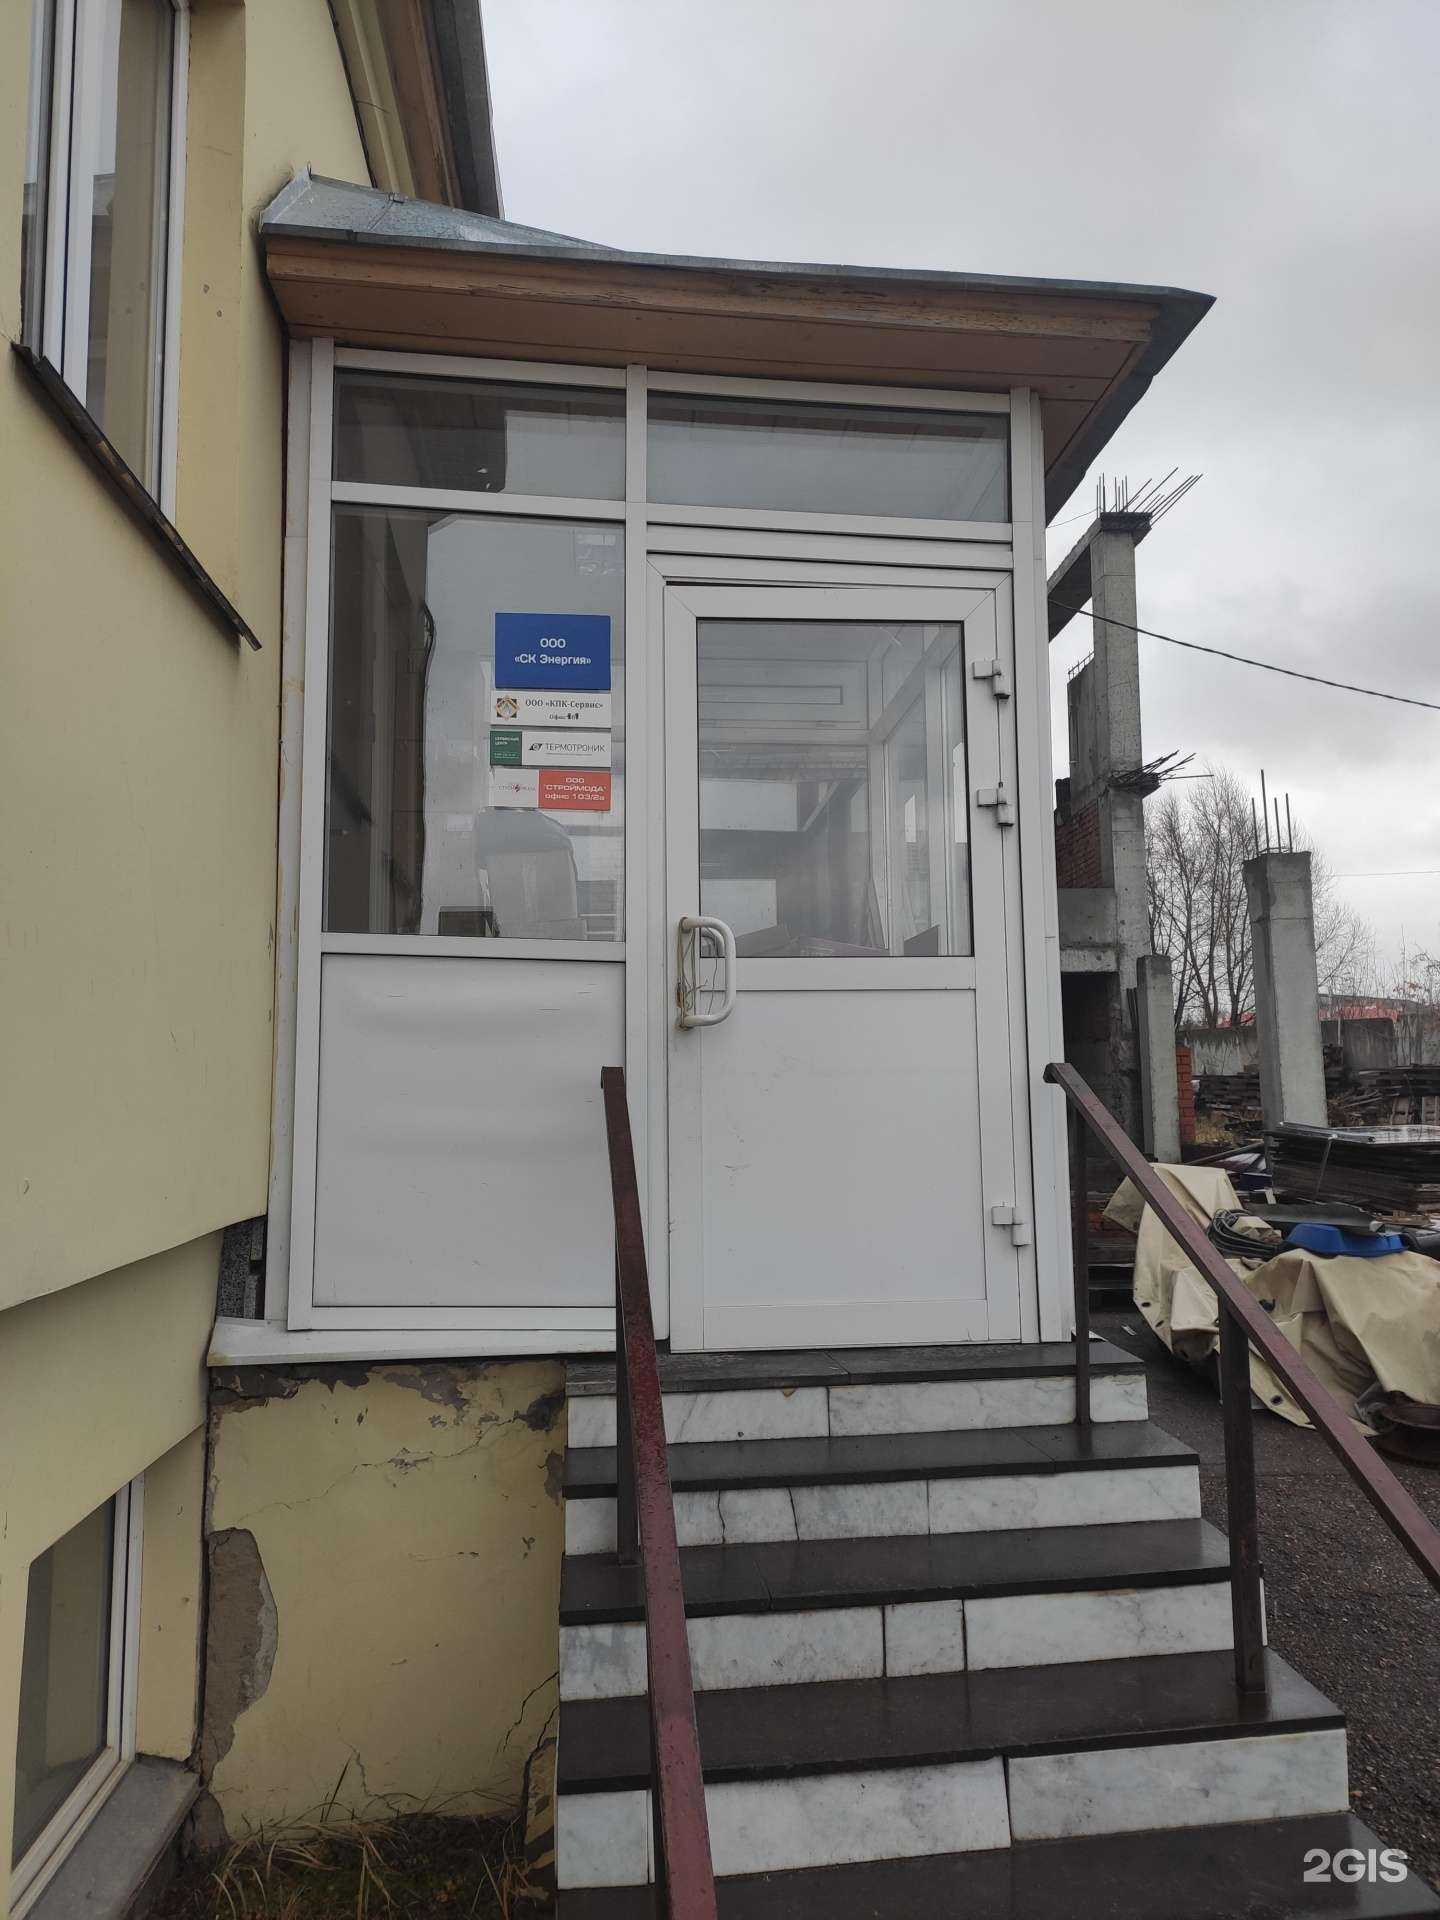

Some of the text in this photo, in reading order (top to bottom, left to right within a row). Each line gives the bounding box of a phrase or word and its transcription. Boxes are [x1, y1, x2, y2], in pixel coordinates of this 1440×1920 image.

[540, 638, 566, 648] ООО
[514, 653, 591, 666] «СК Энергия»
[525, 699, 543, 707] ООО
[545, 743, 606, 752] ТЕРМОТРОНИК
